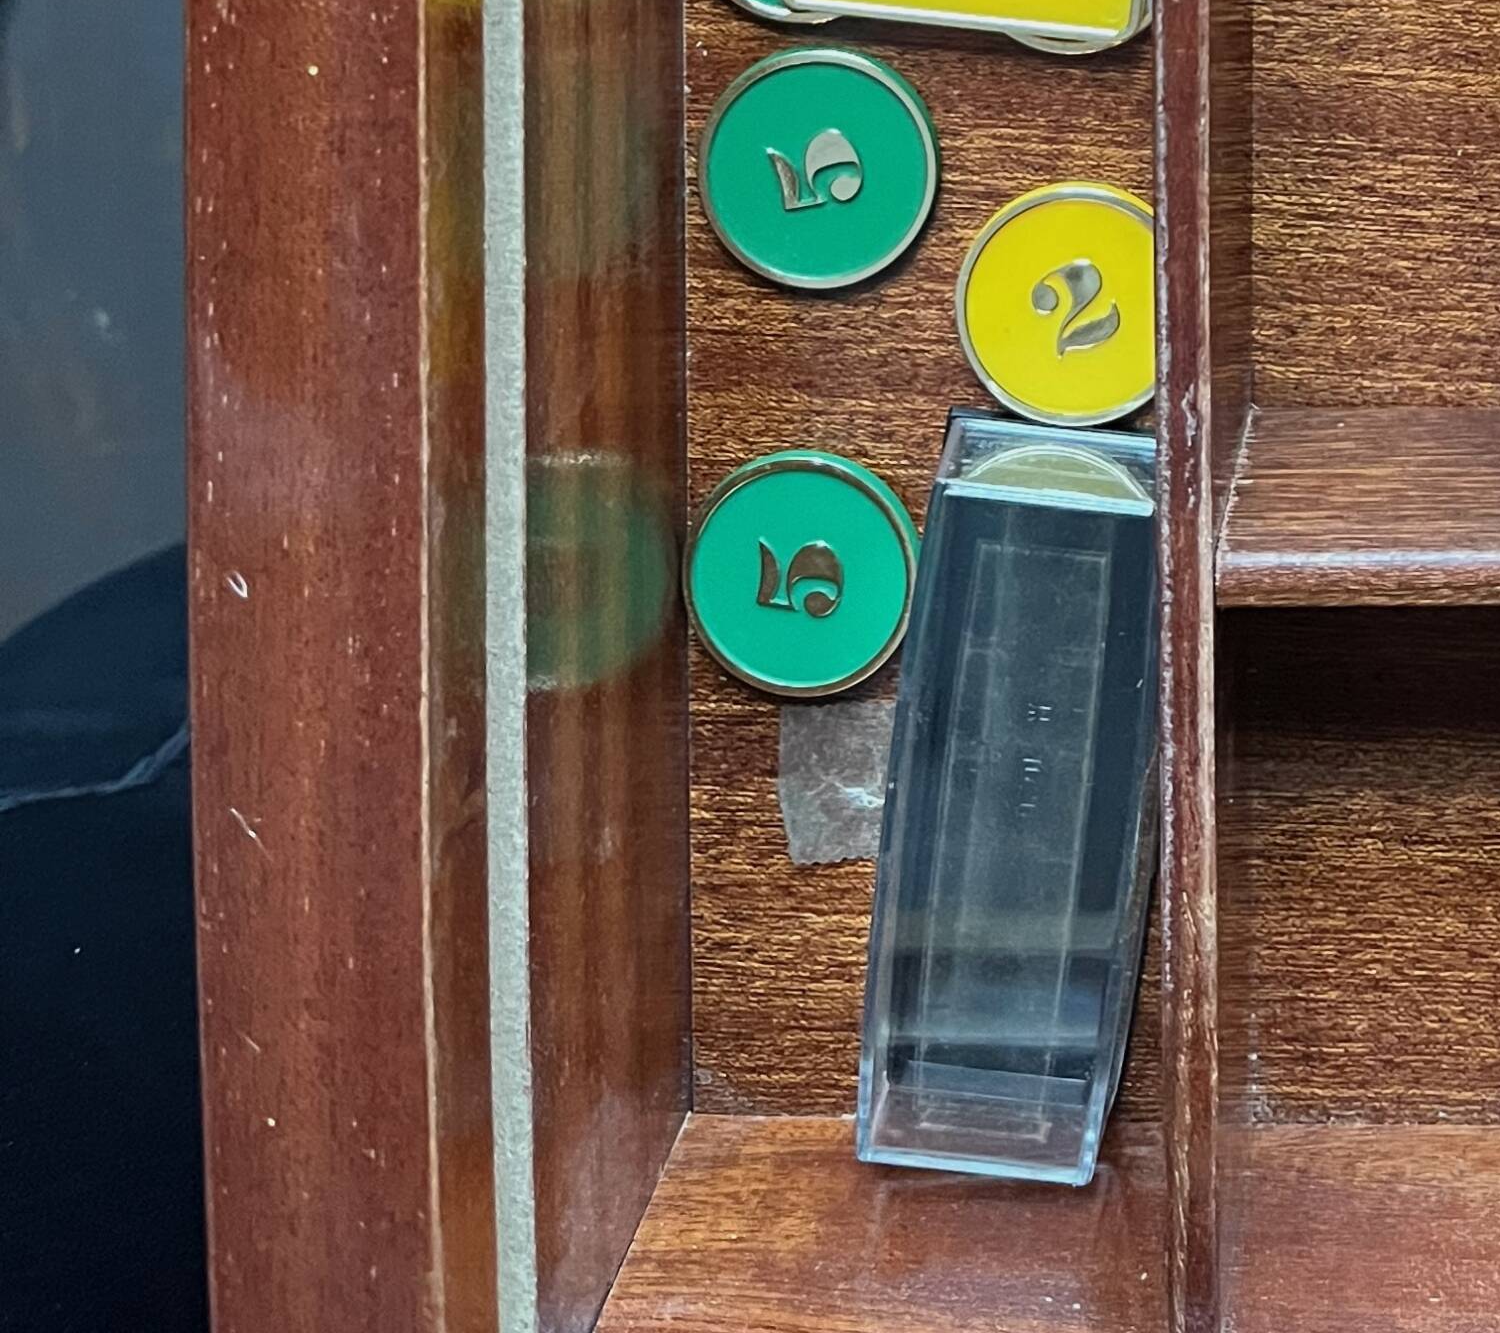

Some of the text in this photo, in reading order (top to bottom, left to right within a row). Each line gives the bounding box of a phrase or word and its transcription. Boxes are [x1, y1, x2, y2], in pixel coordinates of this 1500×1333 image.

[764, 128, 864, 213] 5
[1031, 258, 1120, 360] 2
[757, 536, 844, 618] 5
